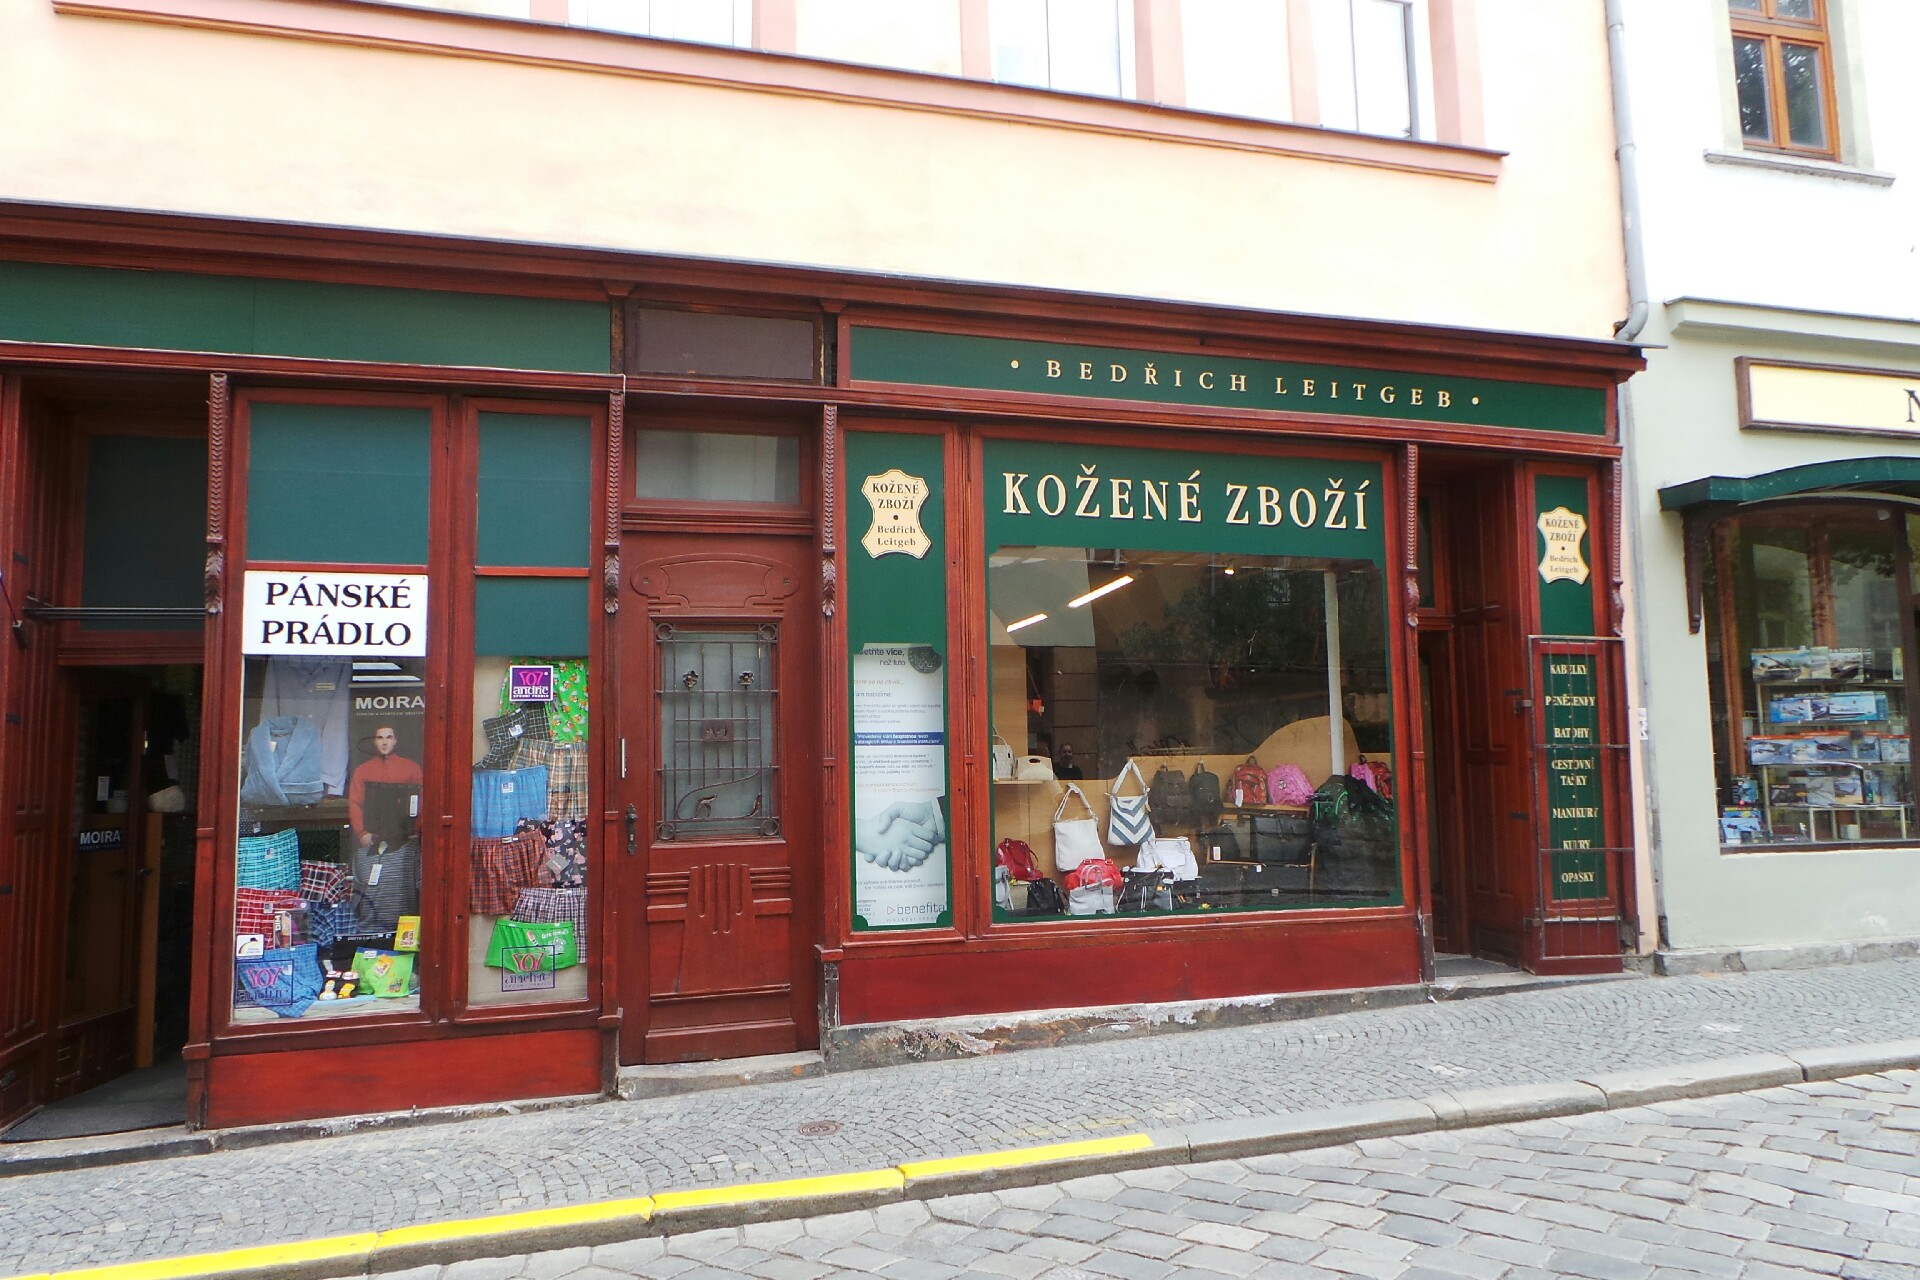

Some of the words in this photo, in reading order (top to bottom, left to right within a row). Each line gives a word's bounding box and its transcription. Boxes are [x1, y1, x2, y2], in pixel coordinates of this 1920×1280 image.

[1046, 360, 1247, 392] BEDŘICH
[1275, 377, 1451, 408] LEITGEB
[872, 480, 920, 494] KOŽENÉ
[878, 496, 916, 510] ZBOŽÍ
[1002, 464, 1202, 523] KOŽENÉ
[1226, 478, 1370, 530] ZBOŽÍ
[1545, 516, 1580, 528] KOŽENÉ
[877, 525, 916, 534] Bedřich
[1550, 530, 1577, 542] ZBOŽÍ
[877, 538, 917, 548] Leitgeb
[265, 576, 411, 609] PÁNSKÉ
[261, 614, 411, 646] PRÁDLO
[355, 695, 425, 709] MOIRA
[1544, 693, 1597, 707] PENĚENY
[80, 830, 121, 845] MOIRA
[1561, 871, 1595, 883] OPASKY
[897, 901, 945, 915] benefita
